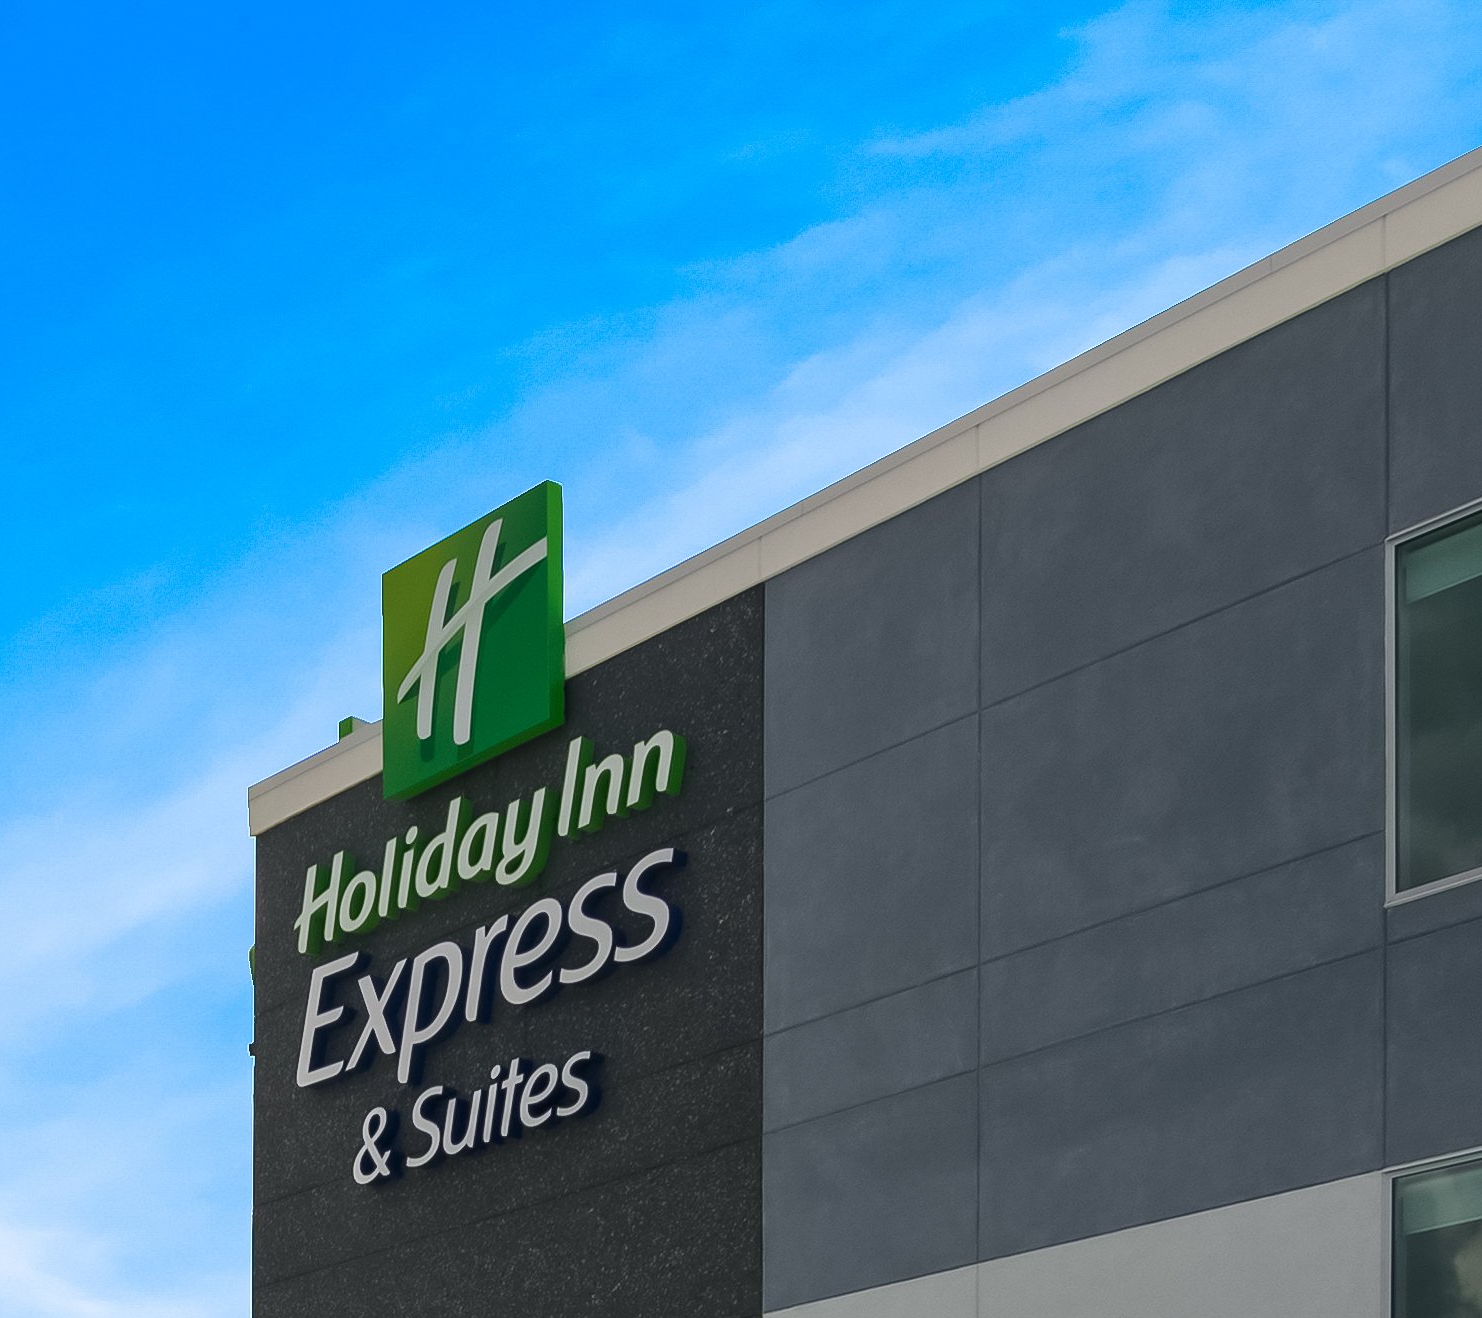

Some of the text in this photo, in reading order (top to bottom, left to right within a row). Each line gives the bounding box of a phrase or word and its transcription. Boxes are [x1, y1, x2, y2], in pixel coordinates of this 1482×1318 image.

[293, 736, 675, 954] Holiday Inn
[296, 848, 675, 1088] Express
[353, 1051, 592, 1184] & Suites
